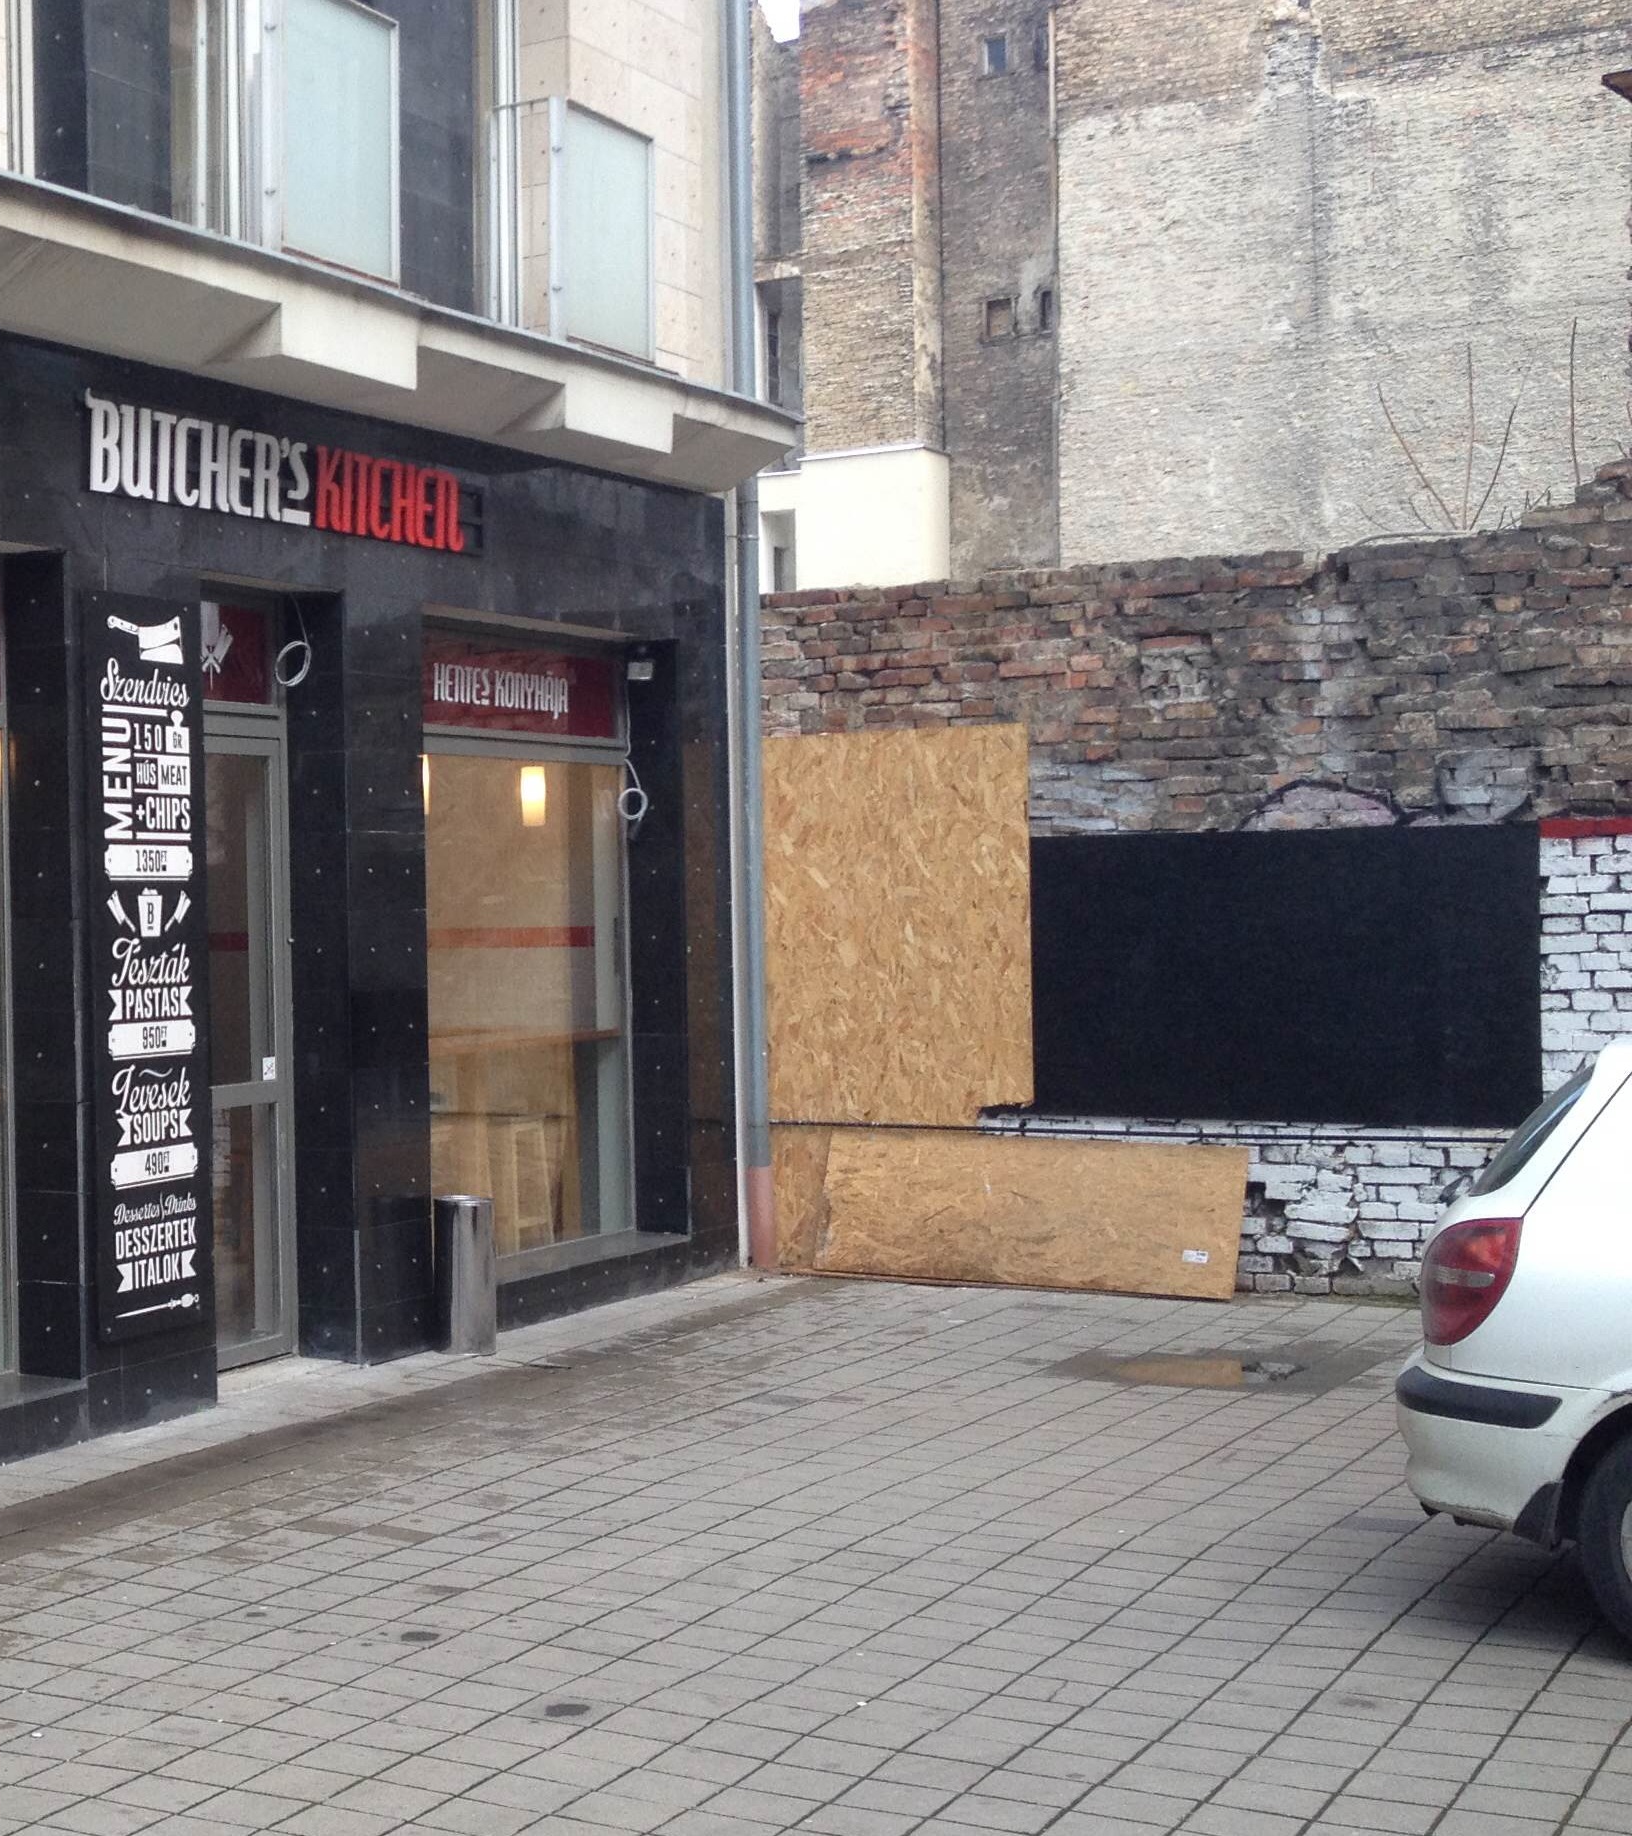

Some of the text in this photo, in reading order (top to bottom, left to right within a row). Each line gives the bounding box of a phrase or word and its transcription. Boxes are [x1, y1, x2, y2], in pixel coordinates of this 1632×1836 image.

[85, 387, 464, 553] BUTCHER'S KITCHEN
[433, 661, 490, 706] HENTES
[133, 722, 163, 752] 150
[101, 717, 134, 840] MENU
[160, 764, 188, 786] MEAT
[125, 986, 180, 1020] PASTAS
[132, 1107, 179, 1145] SOUPS
[114, 1216, 197, 1260] DESSZERTEK
[133, 1251, 181, 1290] ITALOK
